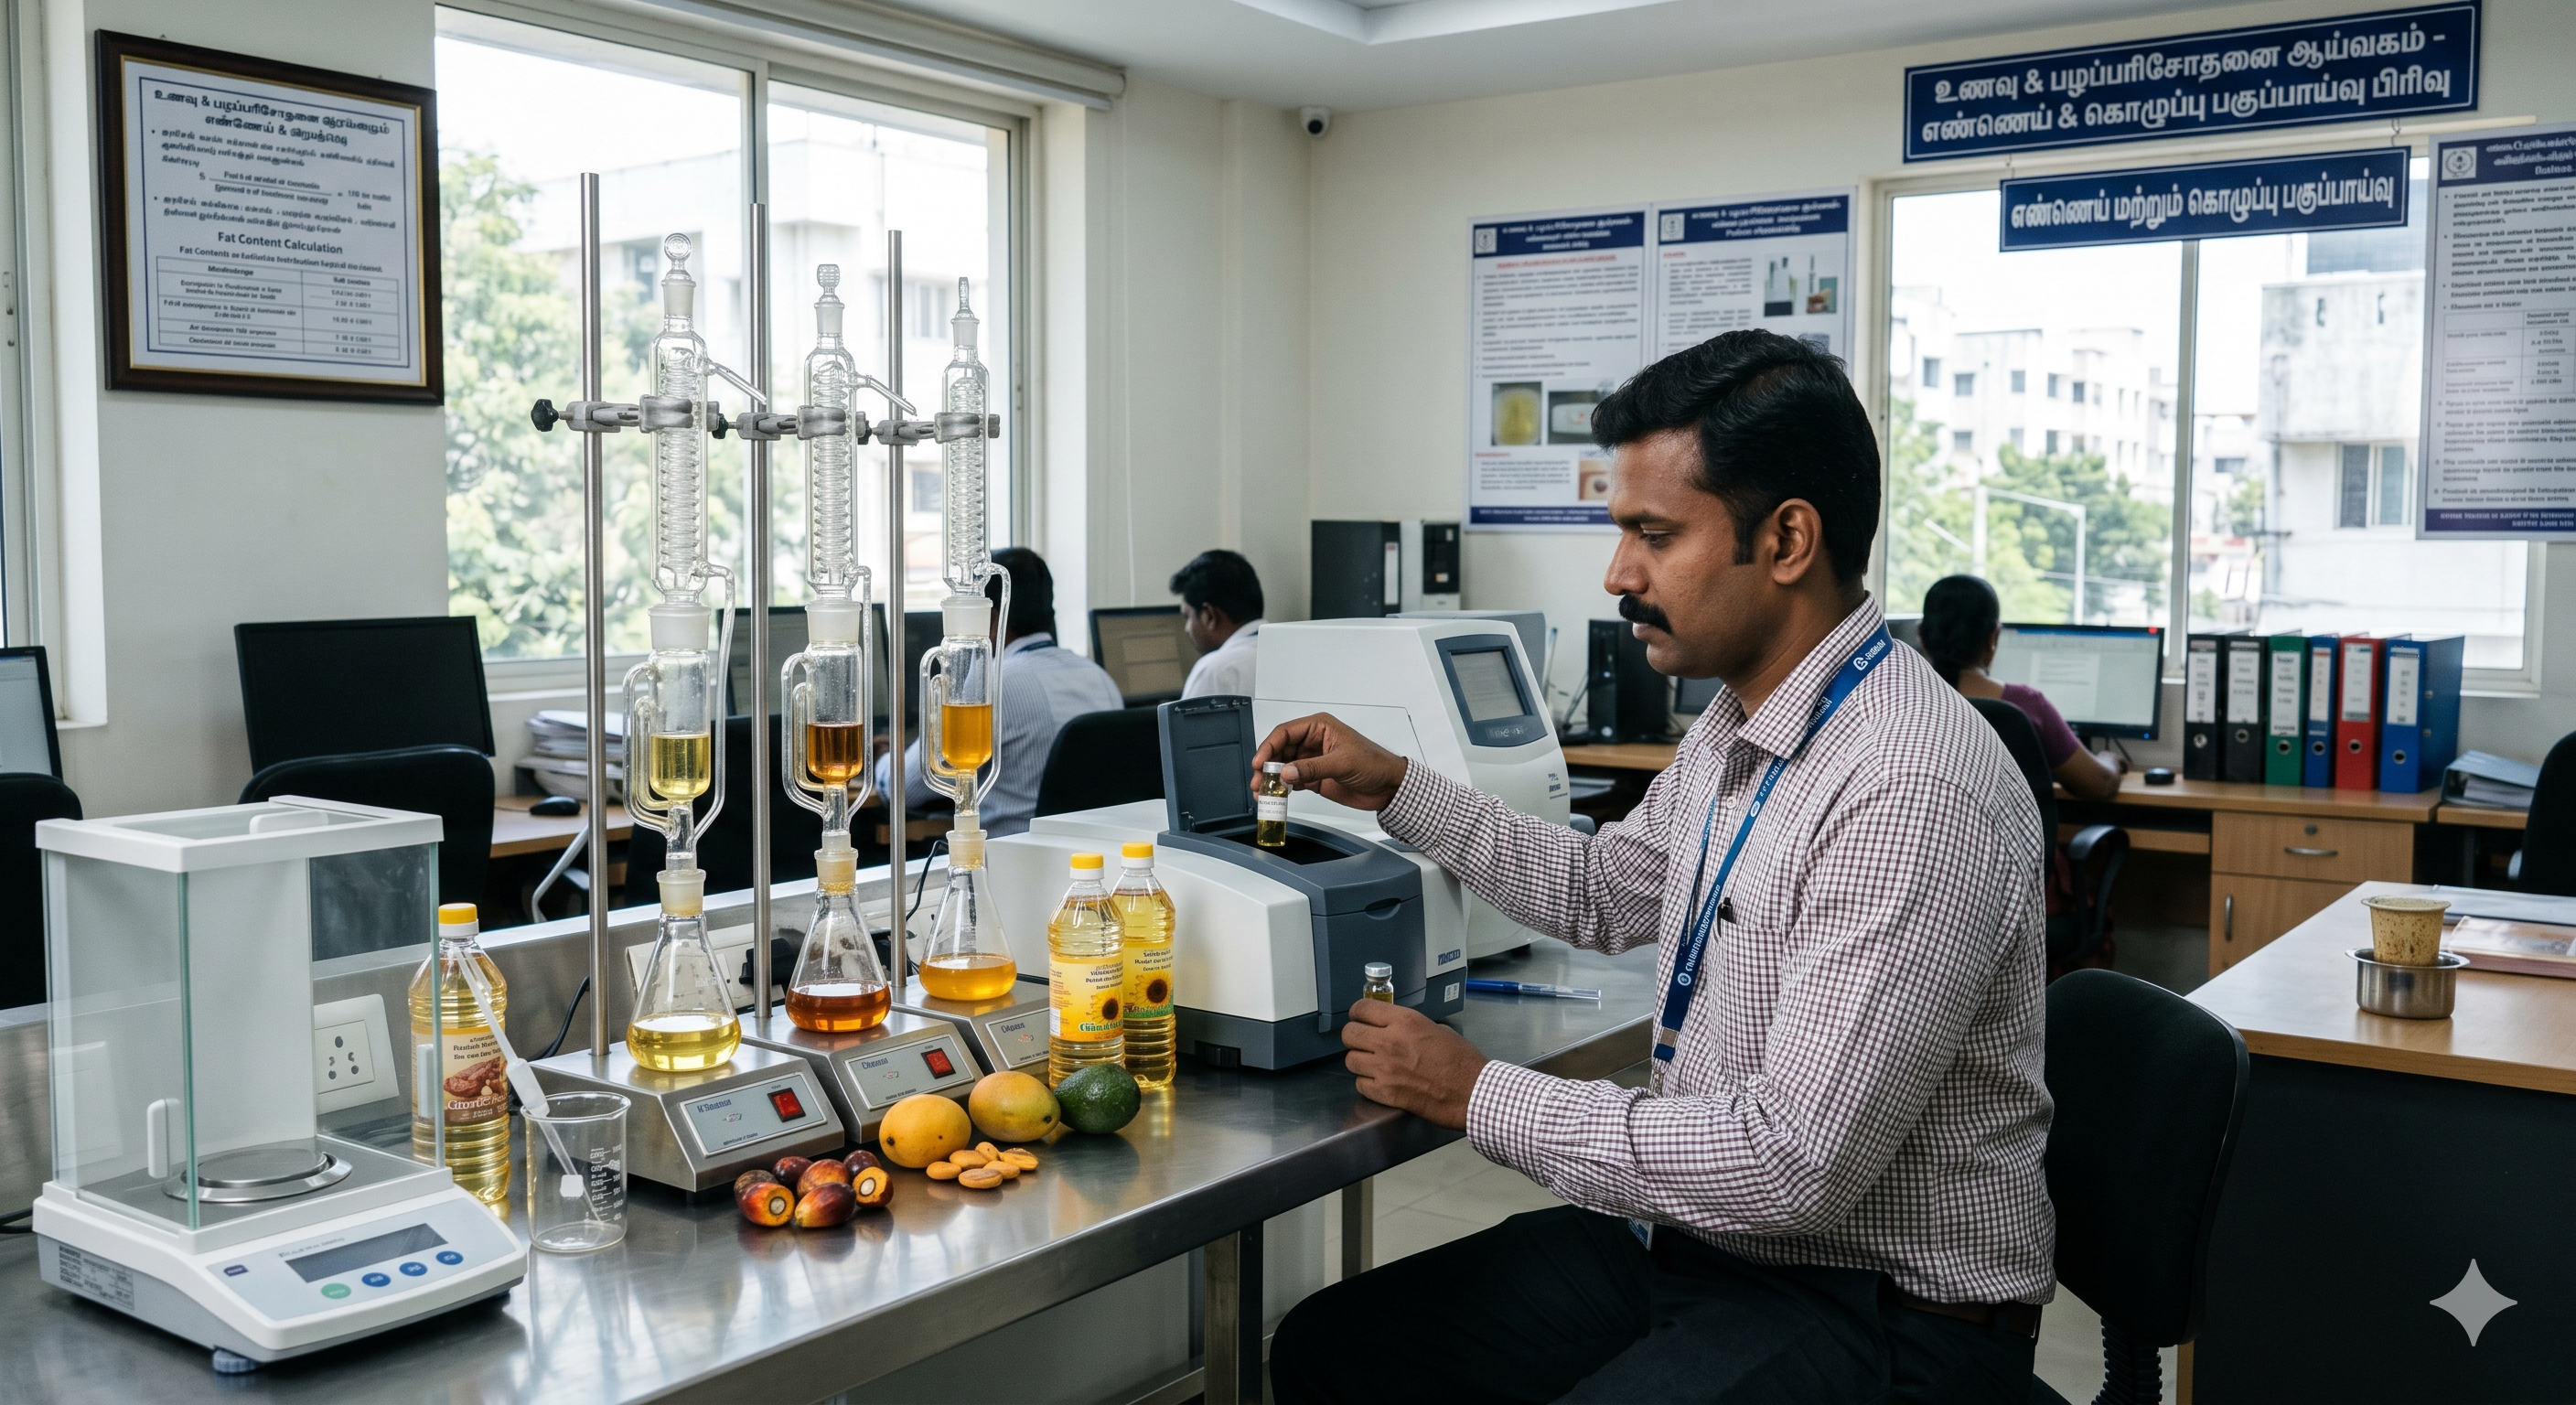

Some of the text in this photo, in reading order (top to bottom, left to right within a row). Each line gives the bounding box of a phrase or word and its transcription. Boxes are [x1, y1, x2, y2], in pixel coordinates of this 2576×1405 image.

[1935, 75, 2018, 104] உணவு
[2024, 69, 2045, 95] &
[2051, 45, 2281, 98] பழப்பரிசோதனை
[2286, 22, 2426, 70] ஆய்வகம்
[201, 95, 210, 107] &
[1922, 63, 2452, 143] எண்ணெய் & கொழுப்பு பகுப்பாய்வு பிரிவு
[278, 124, 287, 136] &
[2011, 167, 2395, 231] எண்ணெய் மற்றும் கொழுப்பு பகுப்பாய்வு
[179, 245, 193, 255] Fat
[218, 231, 343, 255] Fat Content Calculation
